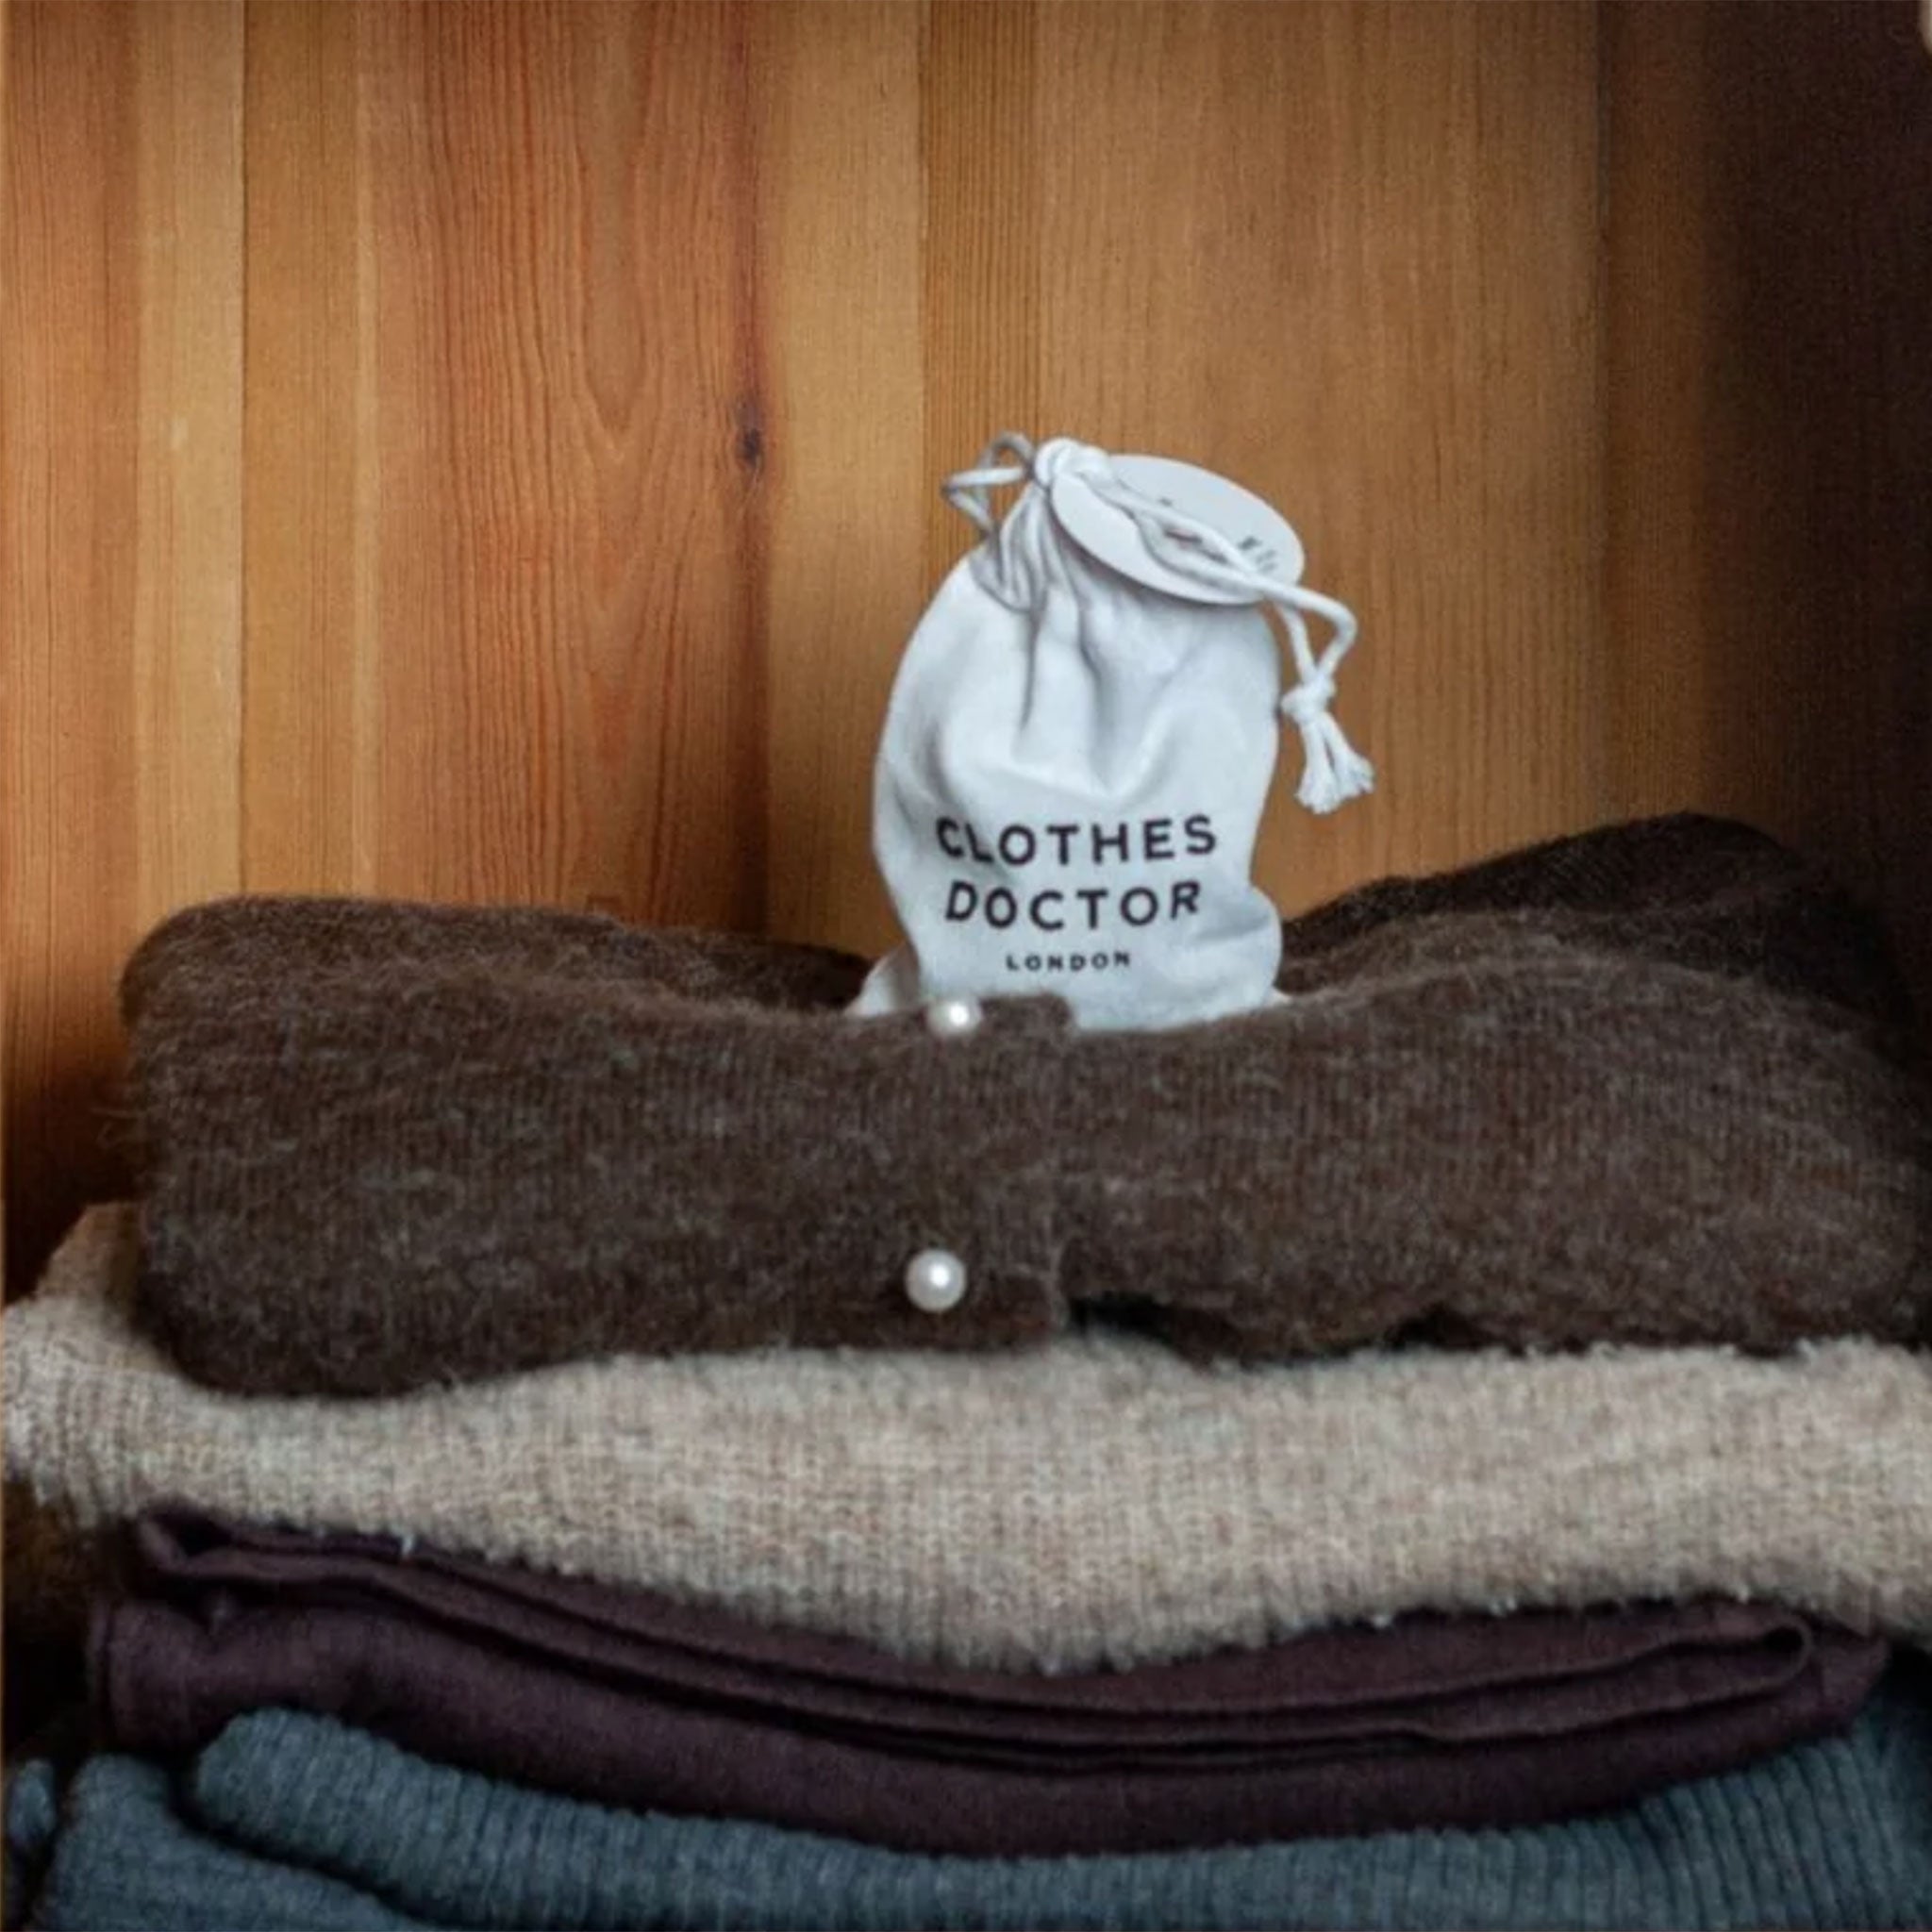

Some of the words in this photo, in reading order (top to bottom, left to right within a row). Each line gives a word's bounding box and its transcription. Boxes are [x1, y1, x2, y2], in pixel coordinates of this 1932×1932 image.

[935, 814, 1217, 867] CLOTHES
[944, 879, 1202, 931] DOCTOR
[1006, 951, 1131, 972] LONDON
